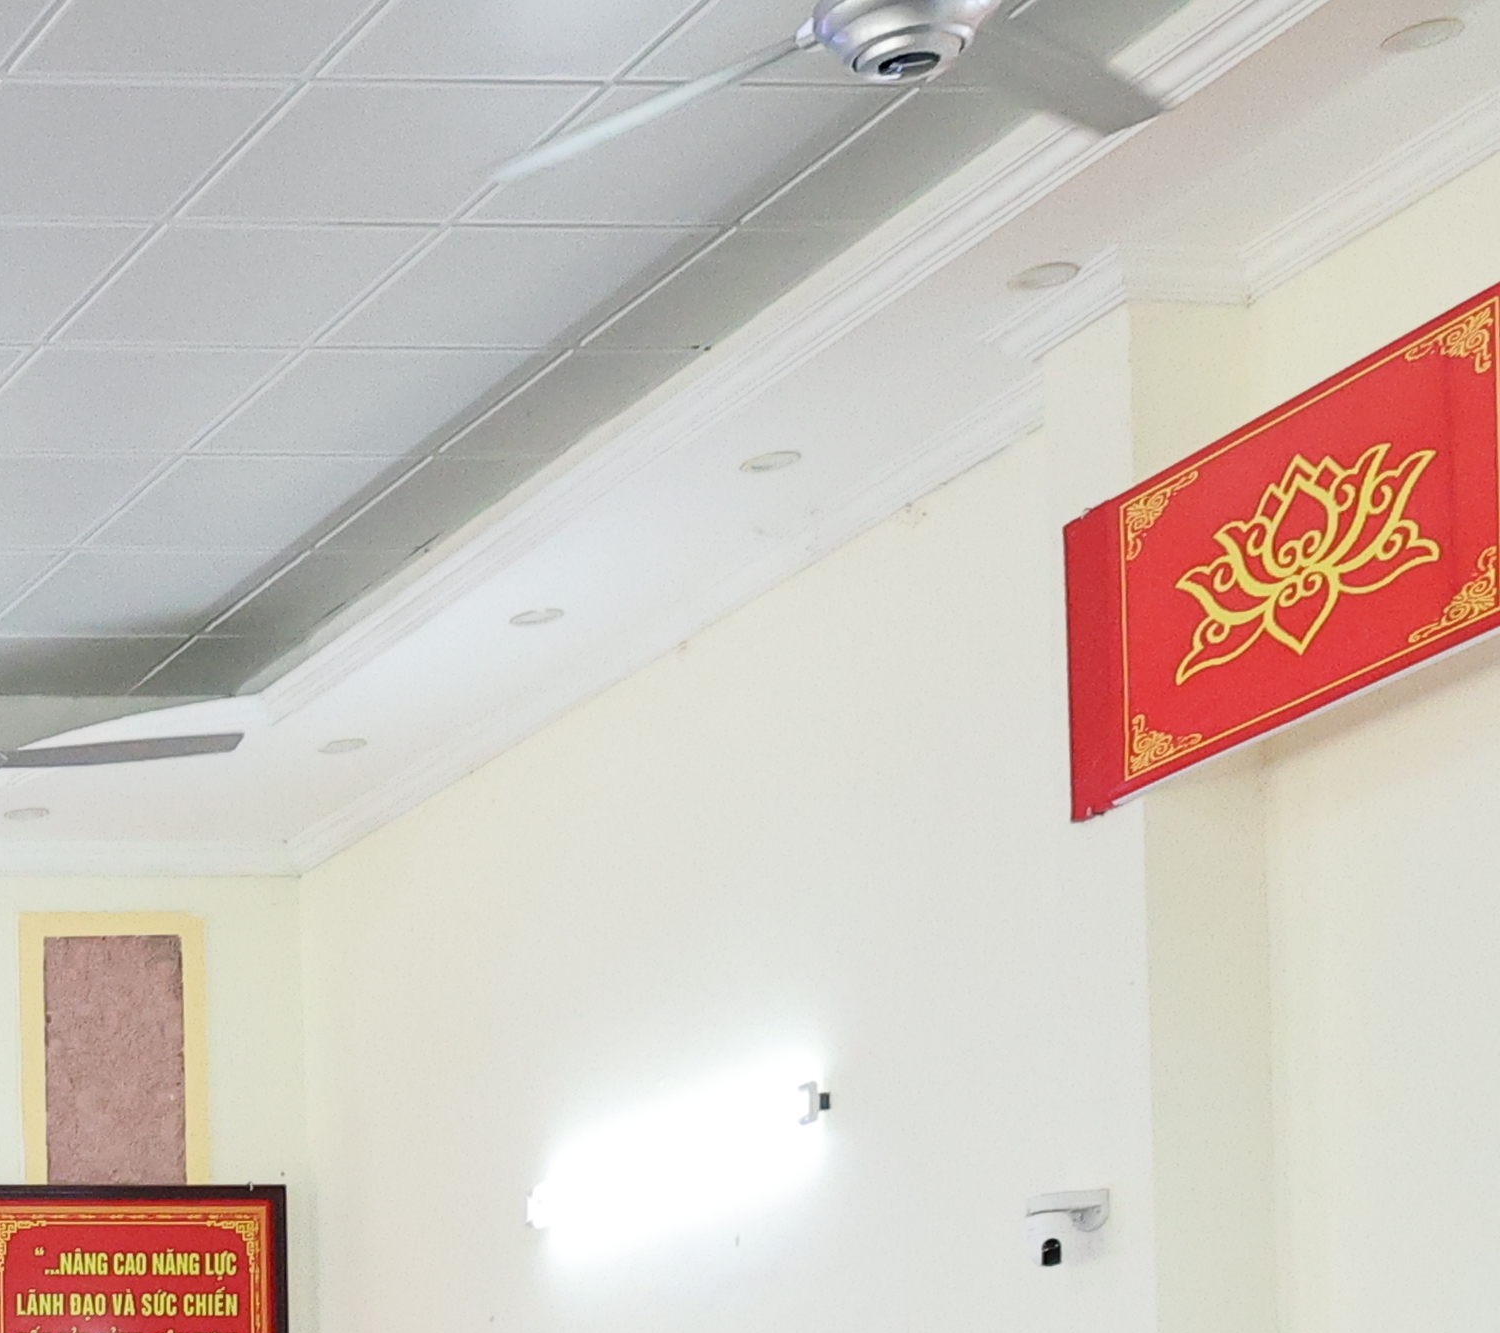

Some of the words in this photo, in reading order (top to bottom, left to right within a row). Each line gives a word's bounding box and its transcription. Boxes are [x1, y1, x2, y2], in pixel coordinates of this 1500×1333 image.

[112, 1252, 148, 1276] CAO
[151, 1249, 201, 1276] NĂNG
[204, 1251, 238, 1281] LỰC
[16, 1289, 64, 1315] LÃNH
[69, 1293, 107, 1320] ĐẠO
[111, 1289, 136, 1316] VÀ
[140, 1289, 178, 1316] SỨC
[182, 1287, 238, 1316] CHIẾN
